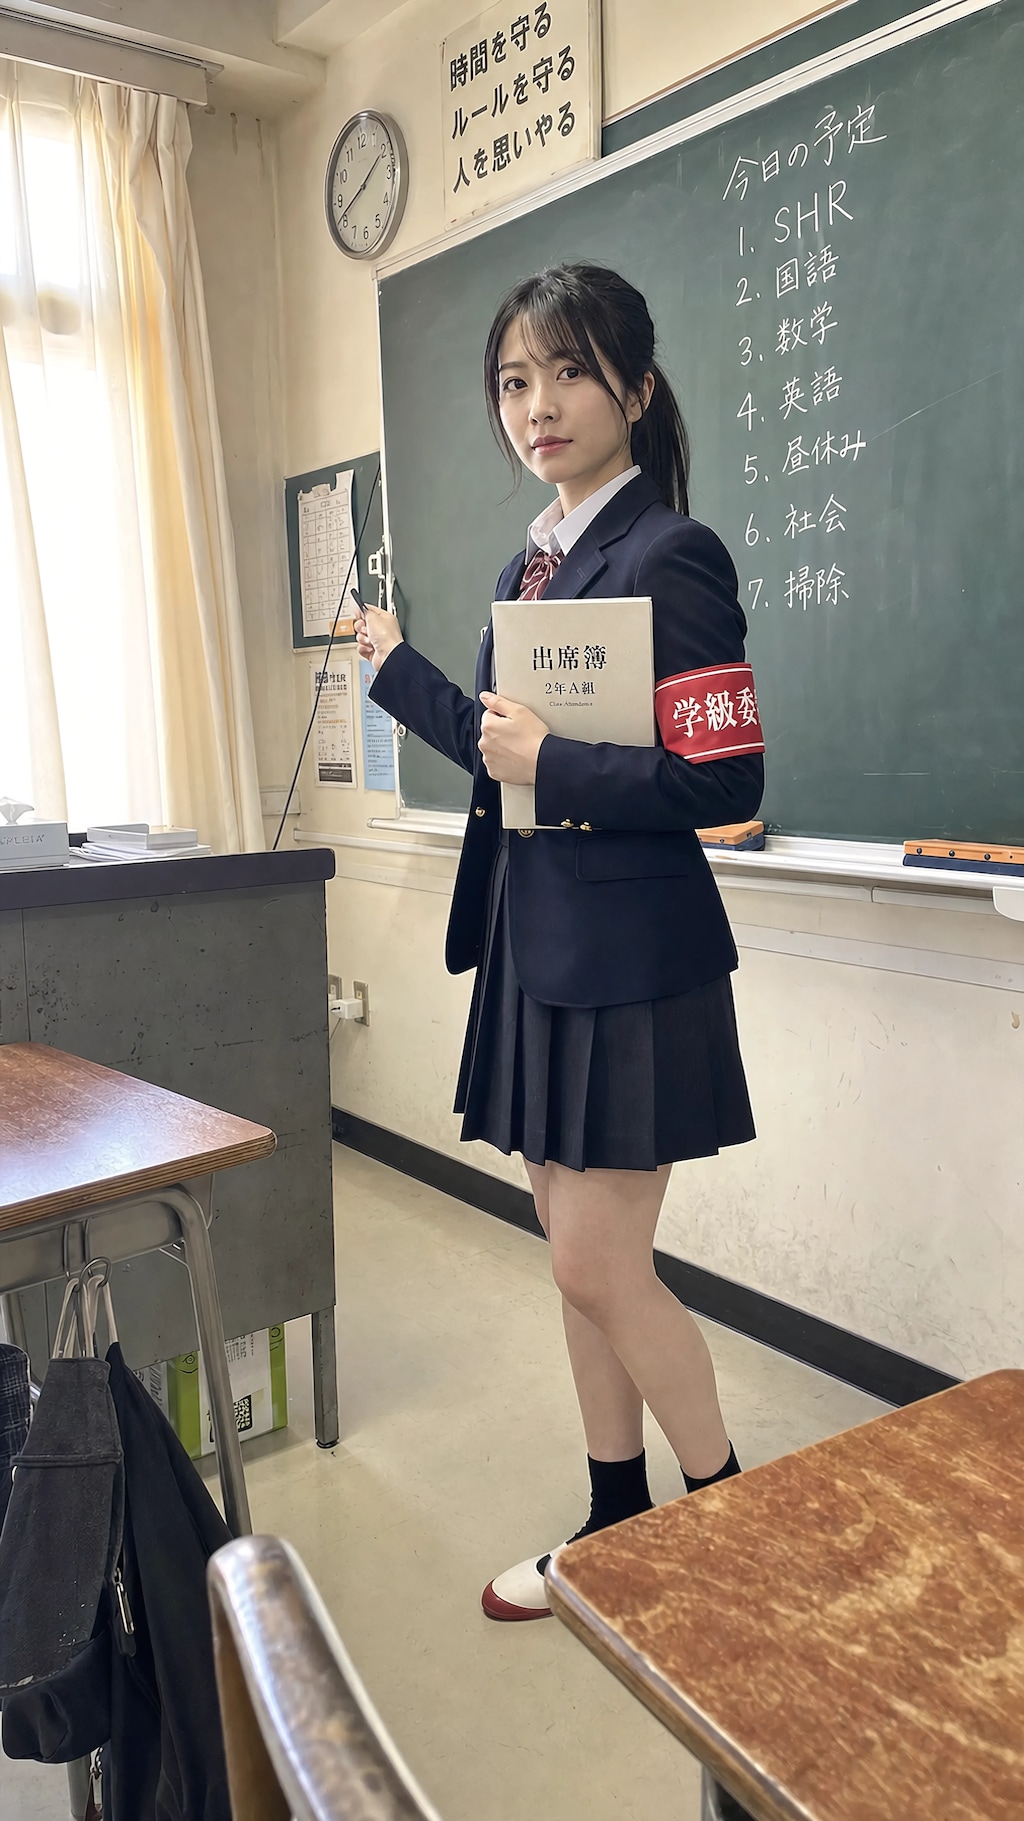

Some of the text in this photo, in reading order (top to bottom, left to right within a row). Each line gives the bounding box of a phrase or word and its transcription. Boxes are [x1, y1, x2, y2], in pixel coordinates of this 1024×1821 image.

[449, 1, 551, 91] 時間を守る
[451, 45, 575, 140] ルールを守る
[357, 133, 367, 150] 12
[380, 143, 387, 159] 2
[452, 101, 576, 193] 人を思いやる
[722, 104, 888, 201] 今日の予定
[346, 148, 354, 163] 11
[340, 169, 348, 185] 10
[386, 164, 392, 180] 3
[337, 193, 343, 208] 9
[383, 192, 391, 206] 4
[774, 180, 854, 243] SHR
[342, 214, 349, 228] 8
[352, 225, 358, 239] 7
[363, 226, 370, 240] 6
[375, 213, 382, 228] 5
[776, 244, 839, 299] 国語
[775, 301, 838, 355] 数学
[778, 365, 843, 420] 英語
[782, 429, 867, 475] 昼休み
[784, 493, 847, 540] 社会
[784, 562, 850, 611] 掃除
[532, 645, 607, 671] 出席簿
[545, 681, 595, 695] 2年A組
[672, 686, 761, 738] 学級委
